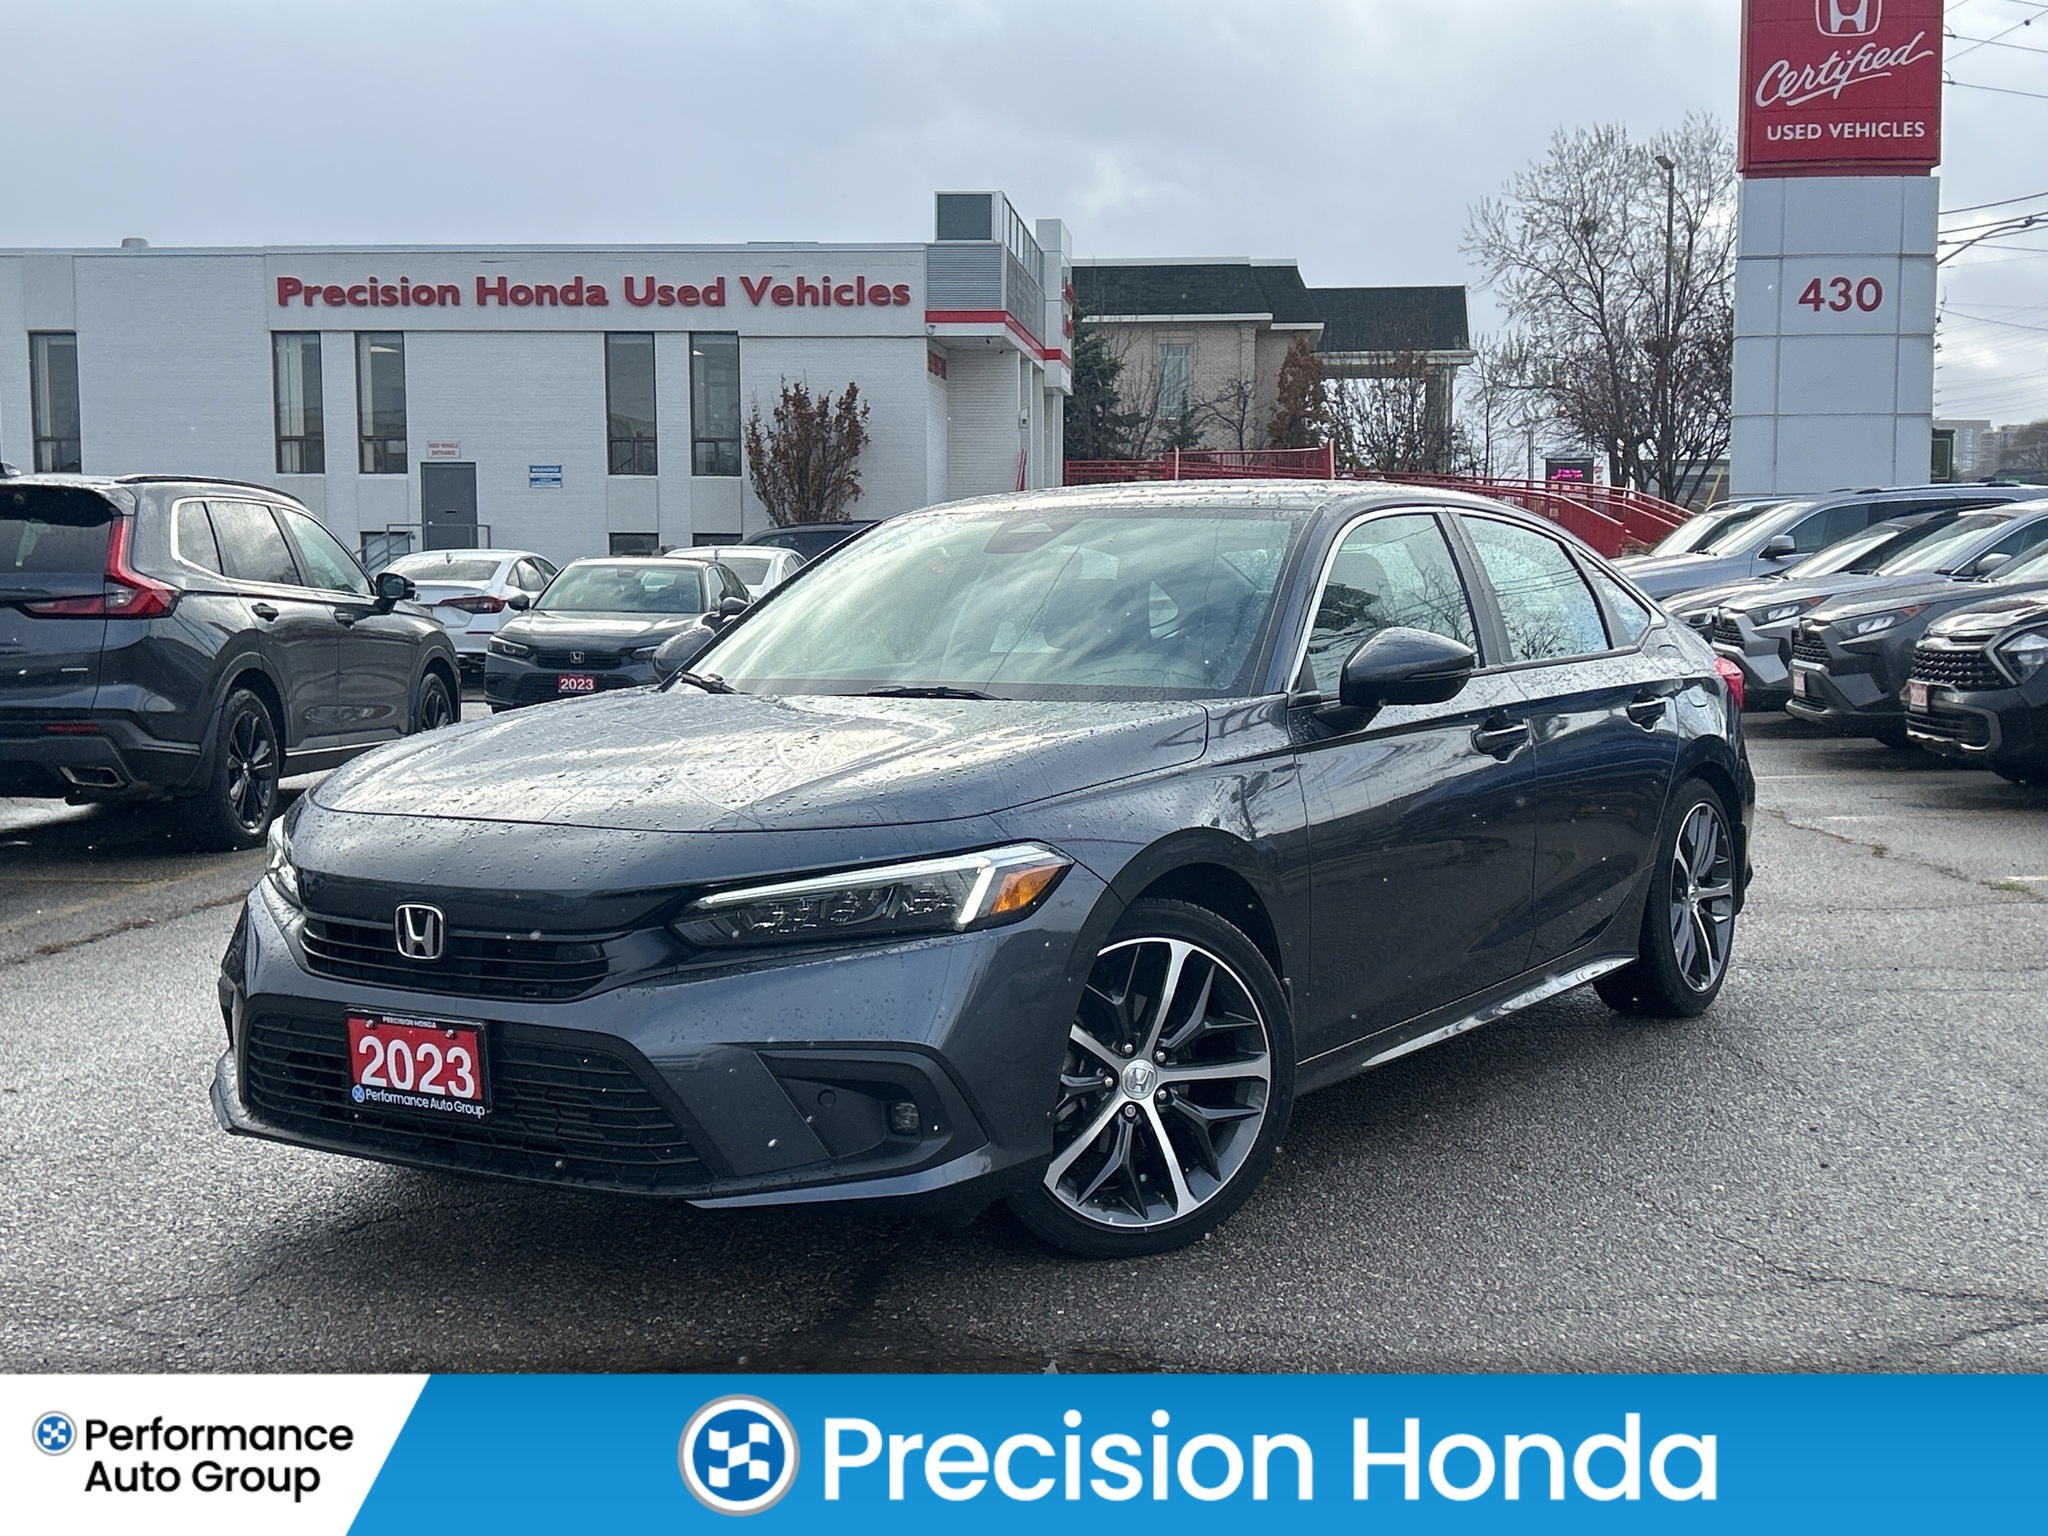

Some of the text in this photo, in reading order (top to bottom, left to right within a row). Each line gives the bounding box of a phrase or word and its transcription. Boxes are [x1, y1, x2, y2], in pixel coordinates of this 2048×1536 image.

[1755, 31, 1934, 107] Certified
[1767, 121, 1925, 141] USED VEHICLES
[277, 276, 911, 306] Precision Honda Used Vehicles
[1798, 277, 1883, 312] 430
[560, 678, 594, 690] 2023
[358, 1035, 475, 1099] 2023
[365, 1088, 486, 1119] Performance Auto Group
